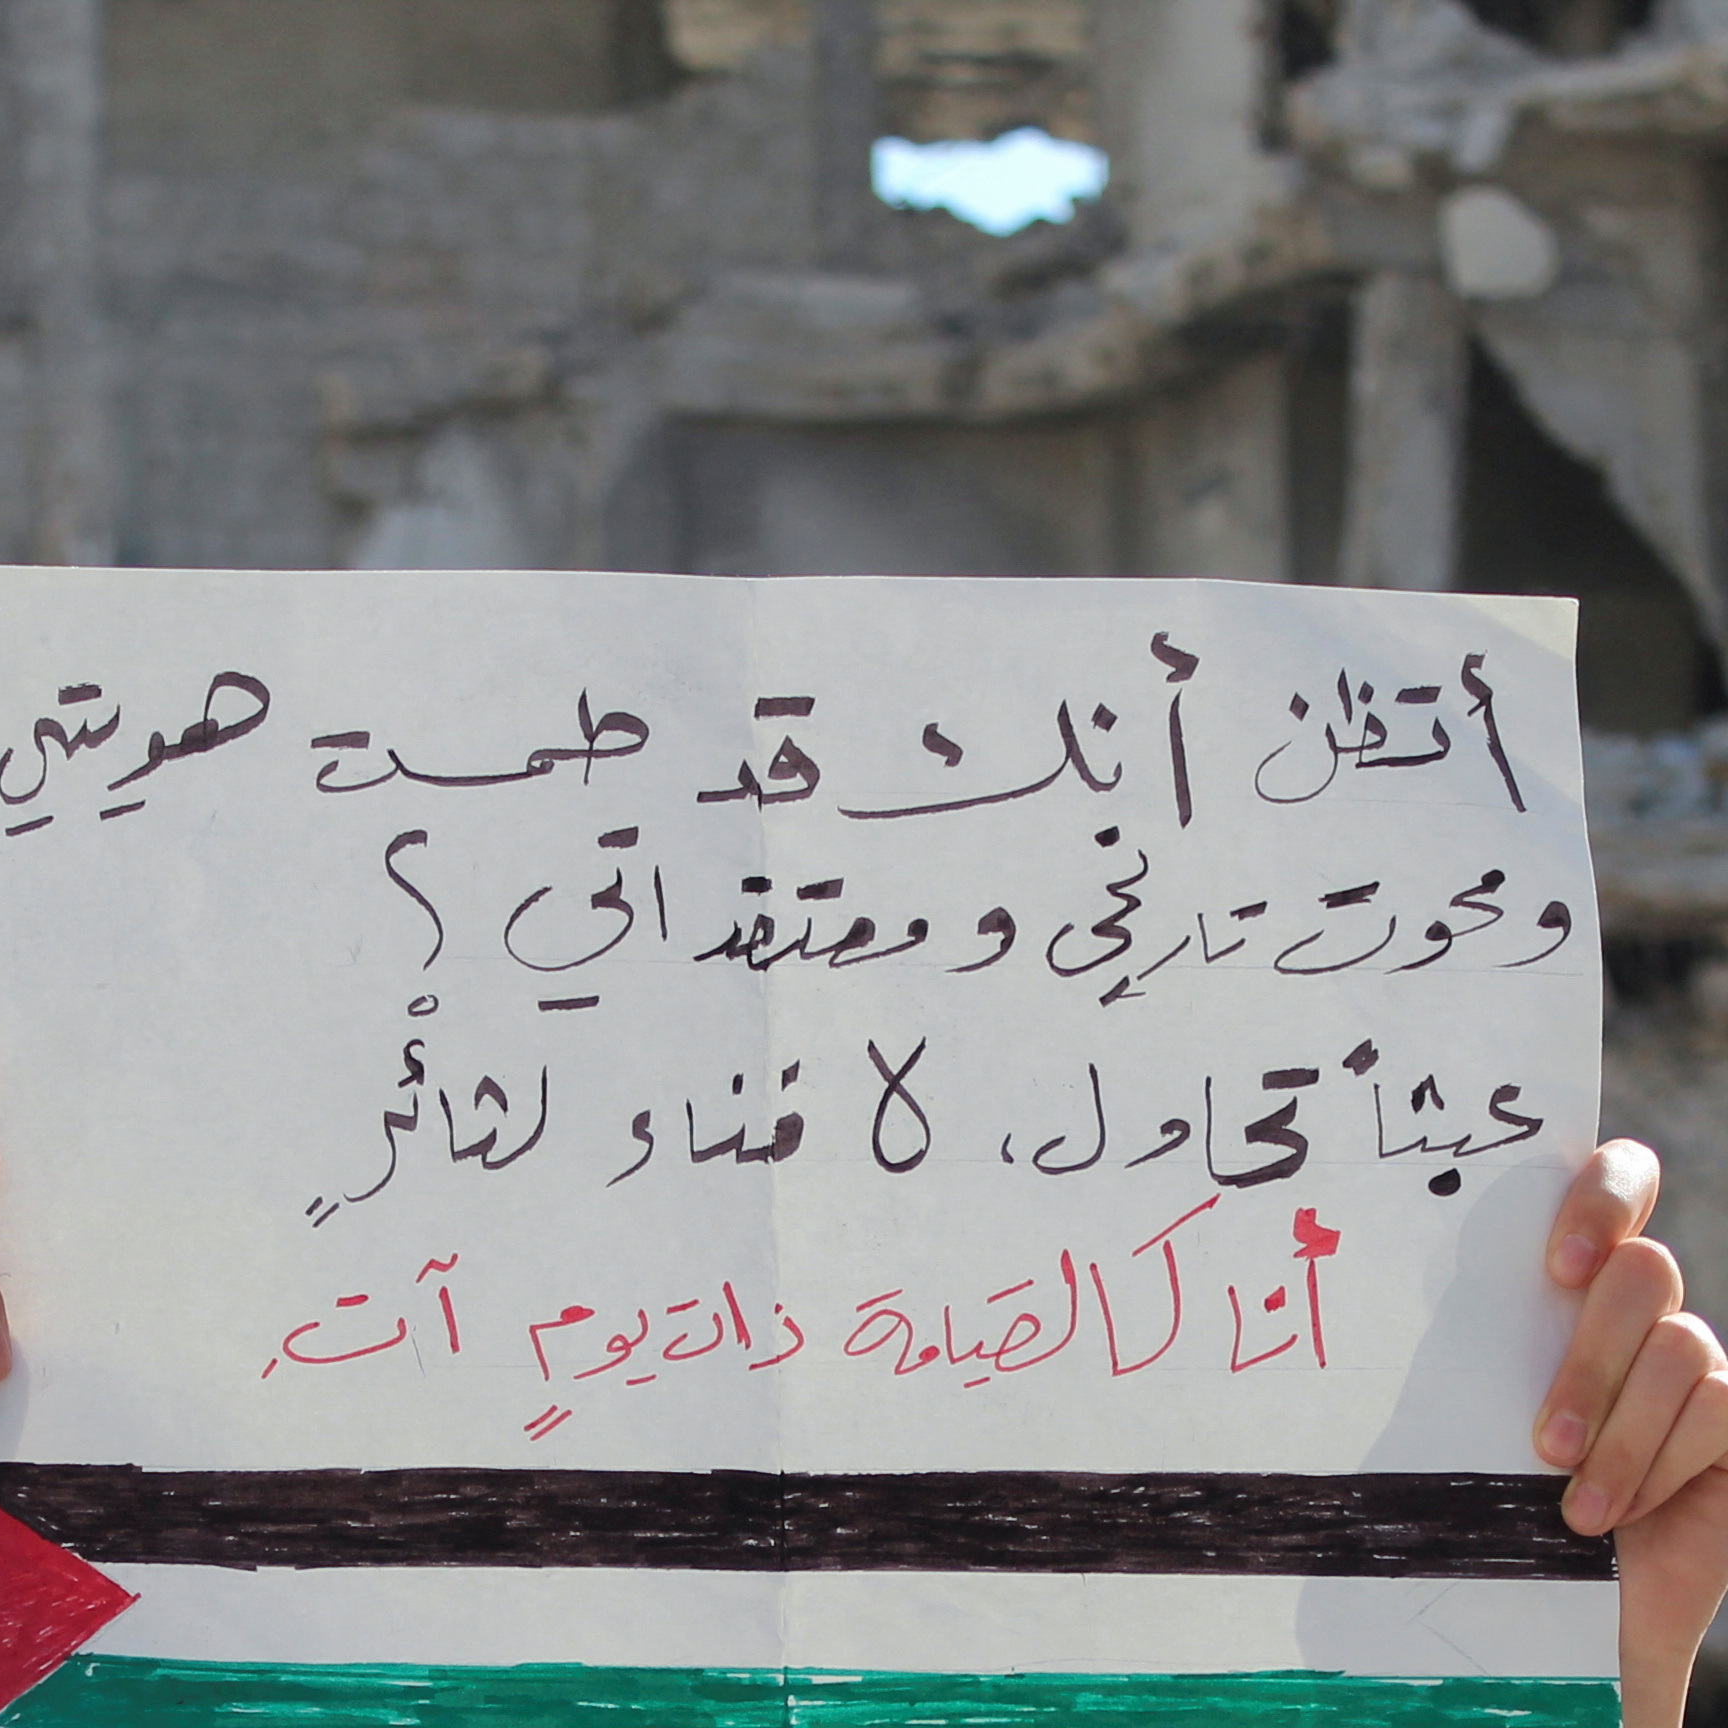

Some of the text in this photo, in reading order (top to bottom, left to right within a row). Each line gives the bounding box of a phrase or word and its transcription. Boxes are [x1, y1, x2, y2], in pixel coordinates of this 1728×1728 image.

[310, 687, 650, 794] طمست
[696, 695, 821, 813] قد
[837, 631, 1201, 830] أنك
[1254, 651, 1529, 814] أتظن
[1044, 825, 1269, 1008] تاريخي
[1273, 868, 1572, 976] ومحوت
[606, 1059, 805, 1188] فناء
[866, 1035, 932, 1174] لا
[662, 1281, 805, 1371] ذات
[1227, 1207, 1342, 1374] أنا
